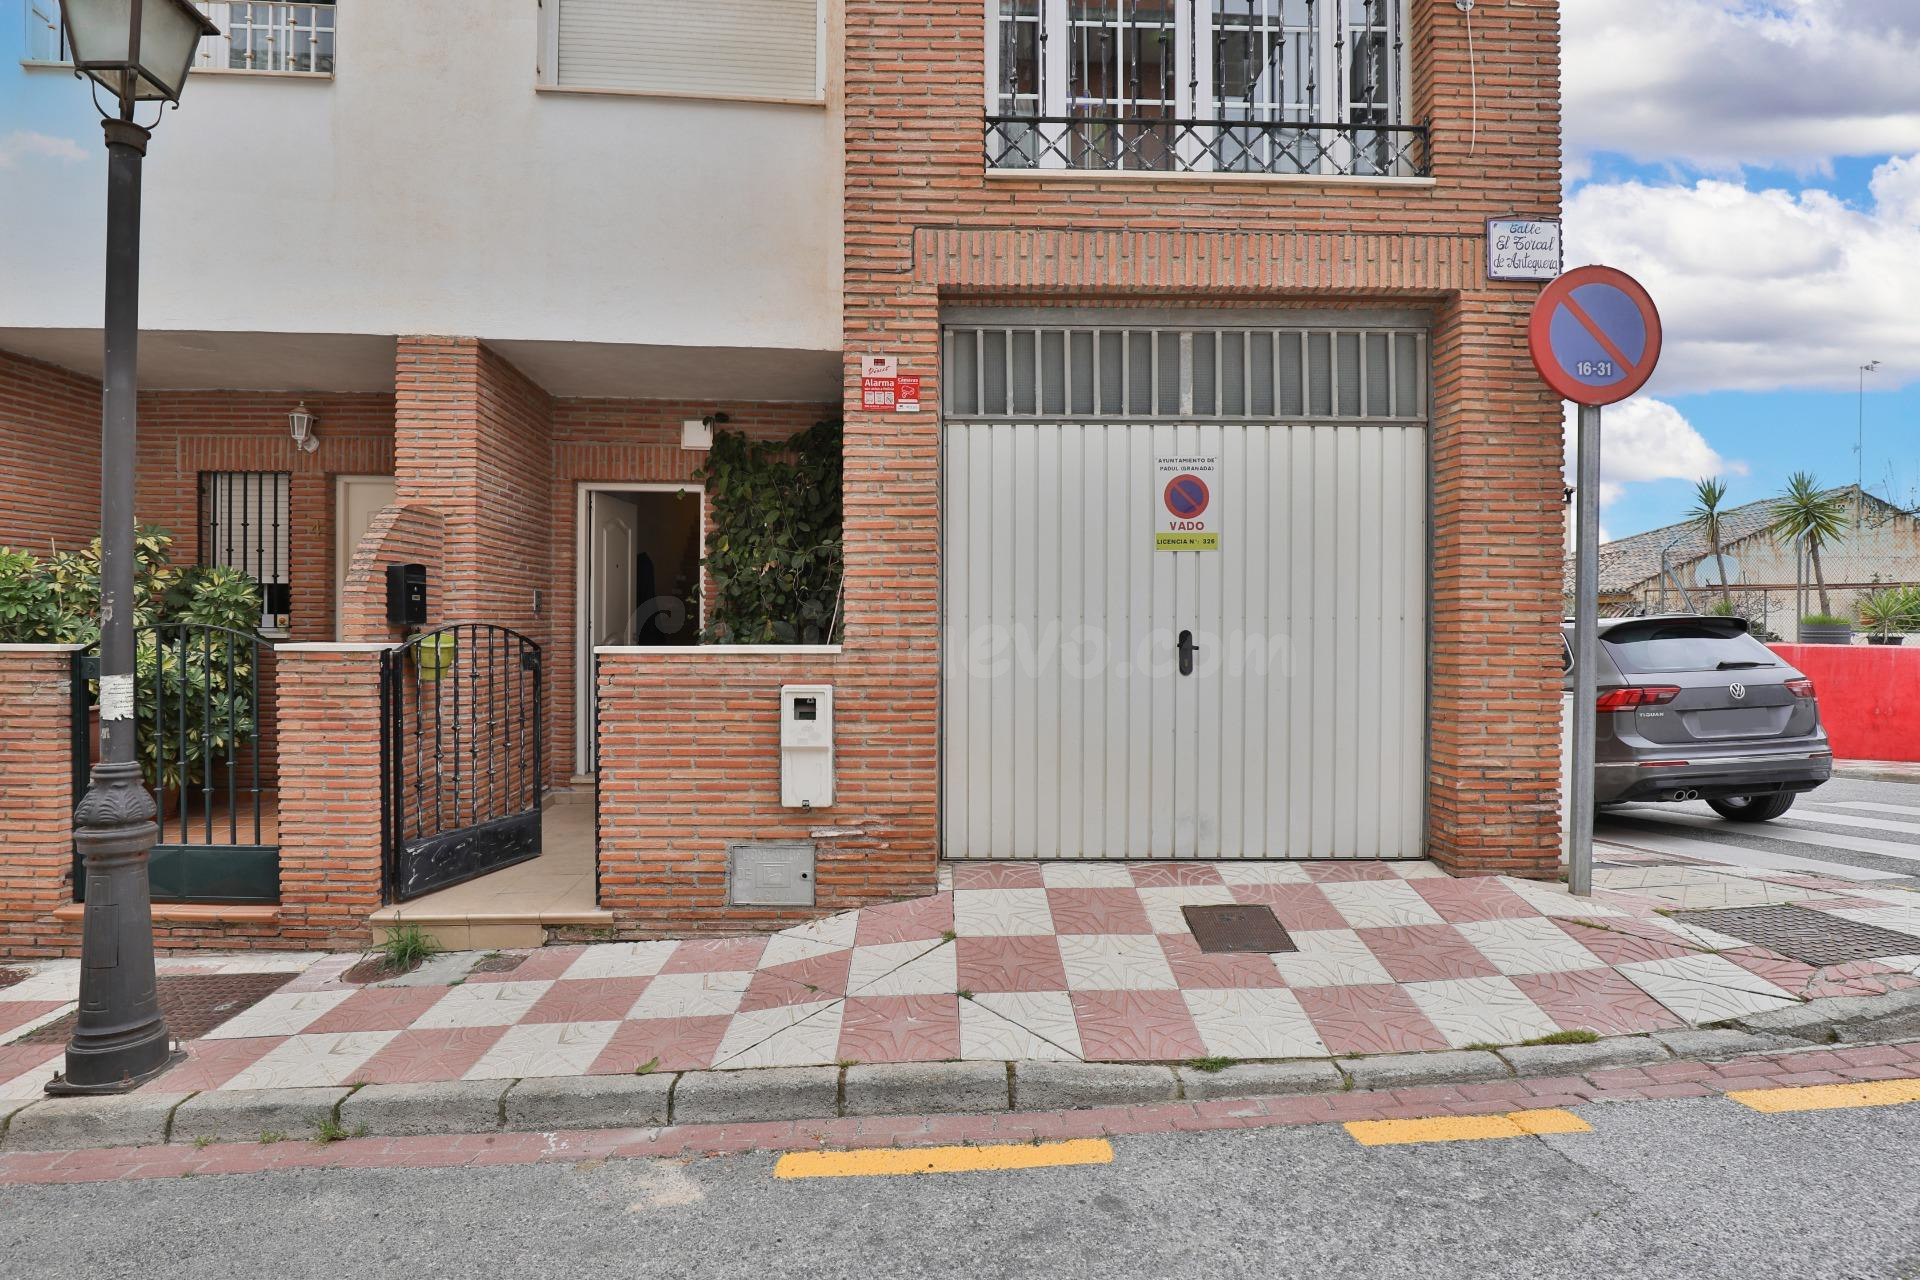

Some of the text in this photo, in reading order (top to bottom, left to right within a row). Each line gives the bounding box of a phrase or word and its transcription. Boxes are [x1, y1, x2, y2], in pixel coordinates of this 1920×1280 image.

[1509, 223, 1542, 235] Calle
[1496, 235, 1556, 251] El Torcal
[1493, 252, 1558, 275] de Antequera
[1576, 361, 1612, 376] 16-31
[864, 378, 895, 387] Alarma
[1169, 521, 1205, 531] VADO
